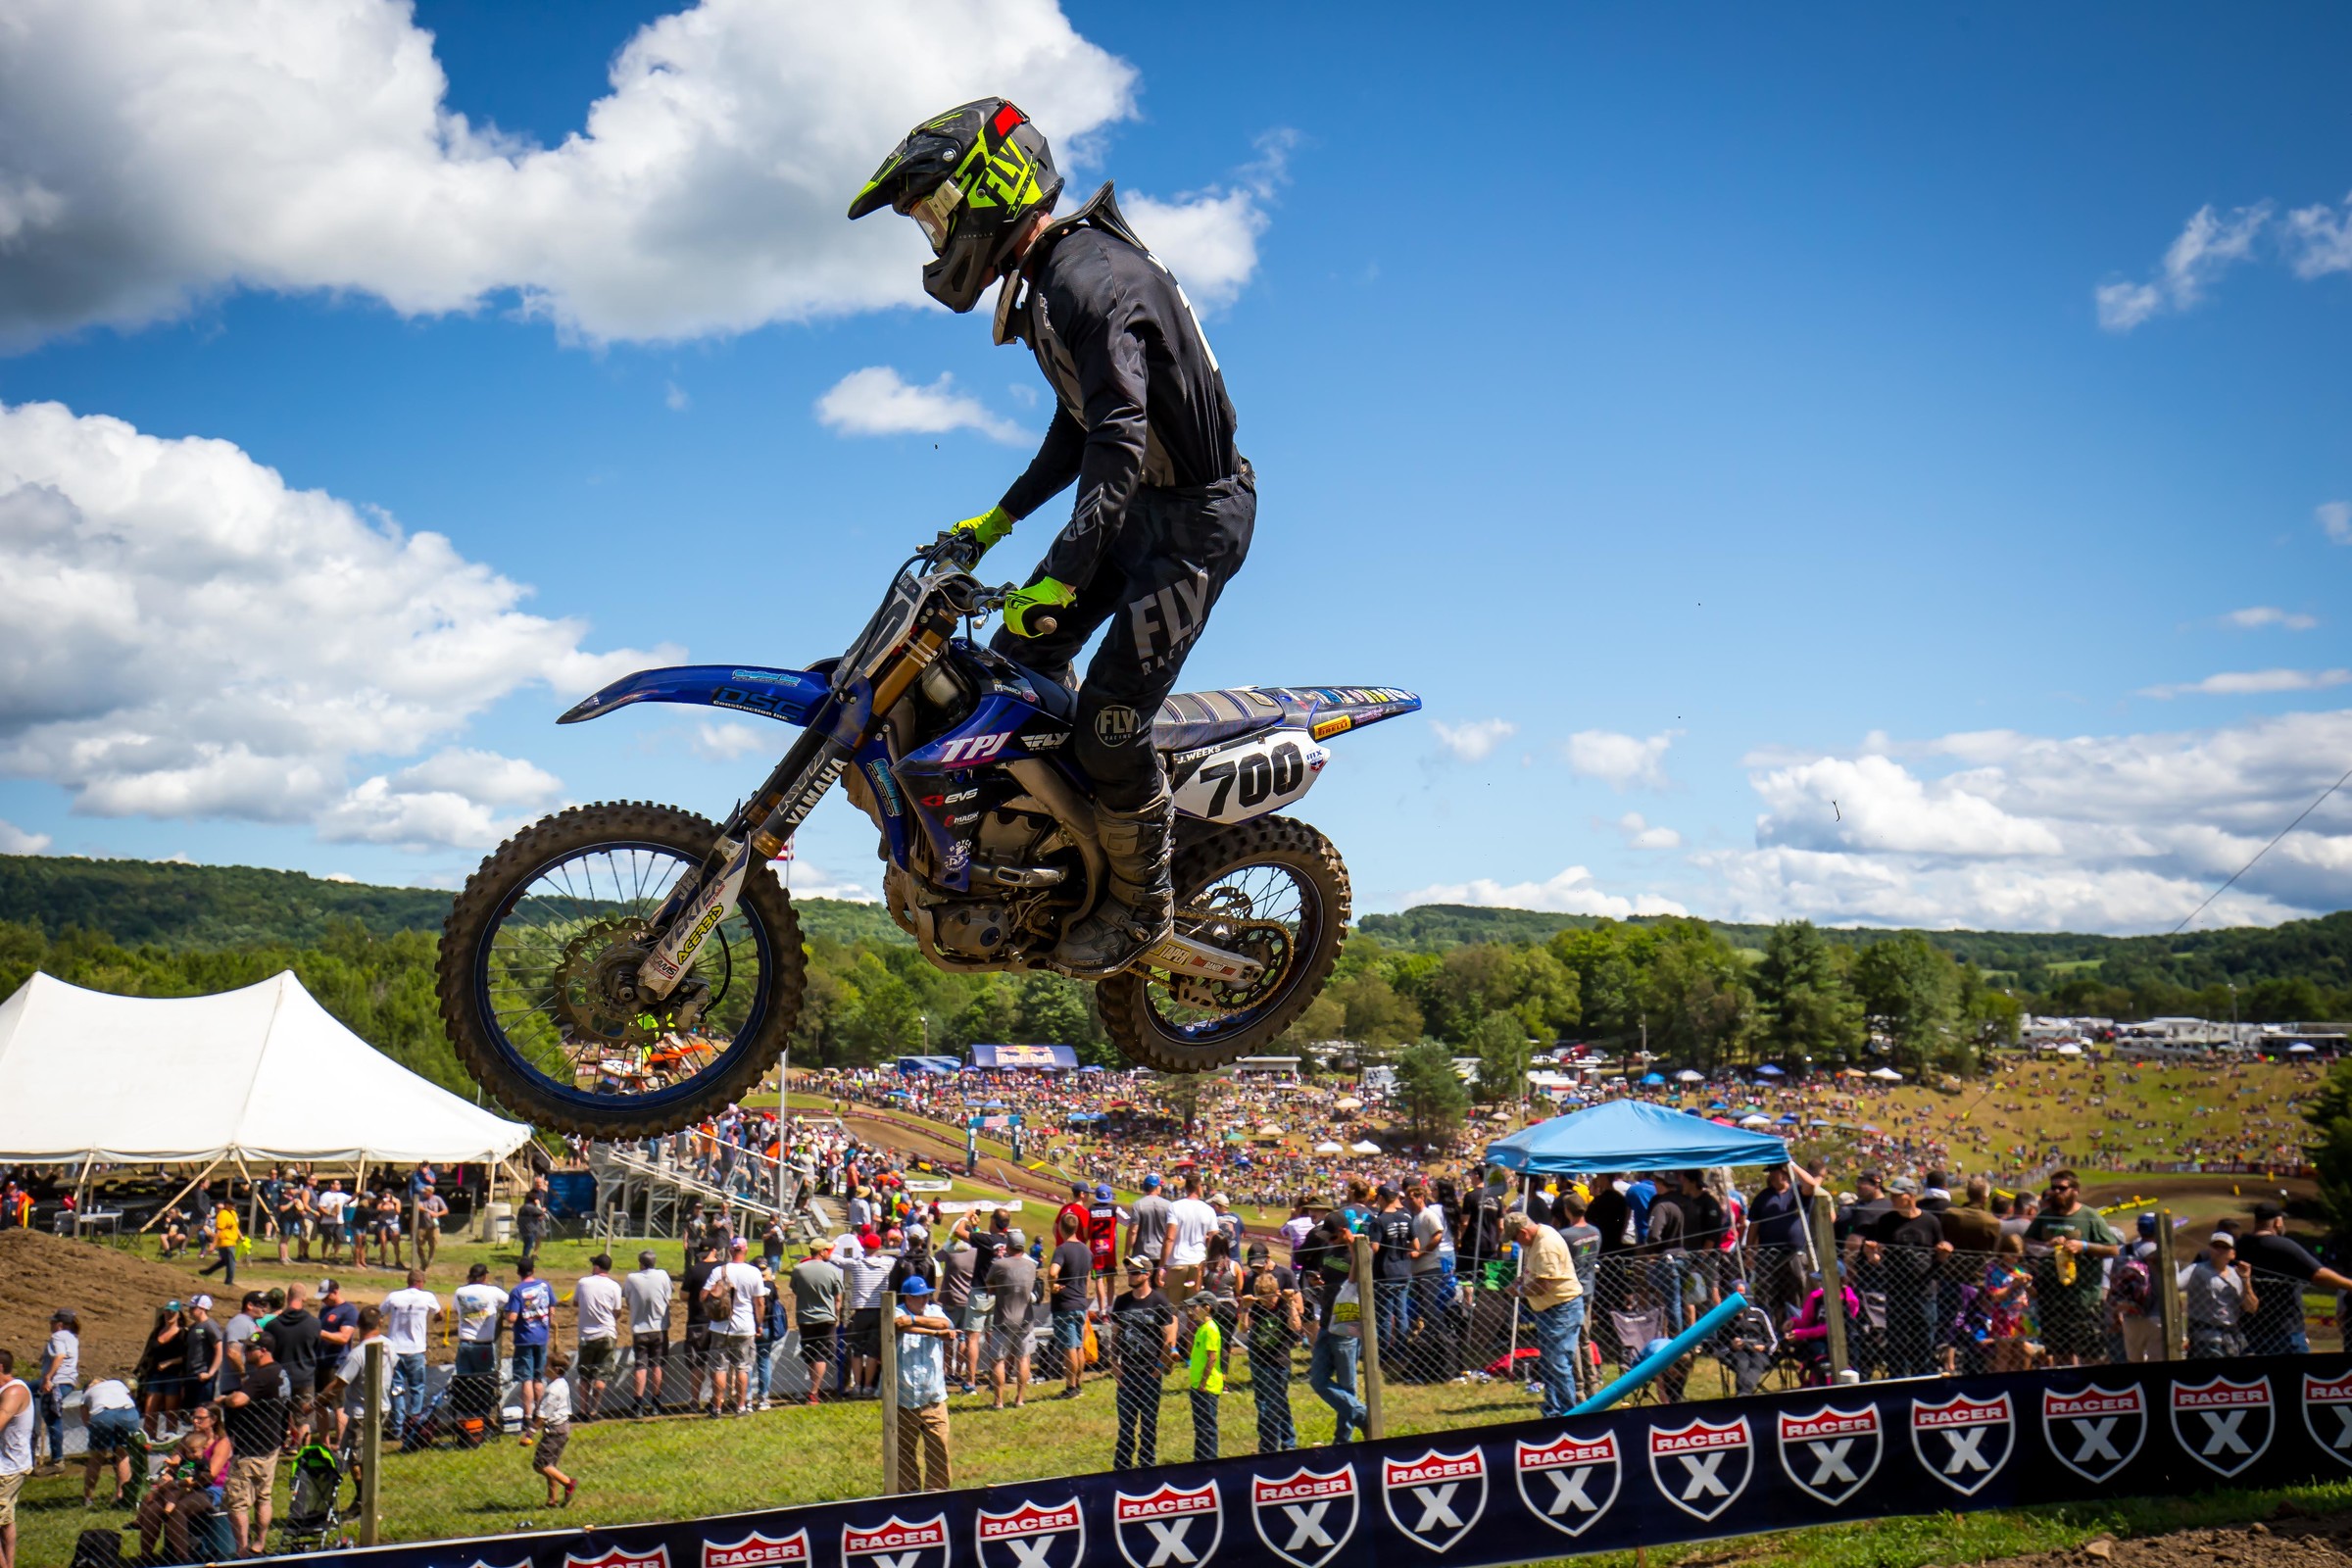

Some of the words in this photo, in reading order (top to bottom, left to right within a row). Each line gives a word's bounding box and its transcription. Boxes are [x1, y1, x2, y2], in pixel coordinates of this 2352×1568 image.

[976, 141, 1026, 208] FLY
[1011, 163, 1037, 212] RACING
[1128, 568, 1208, 660] FLY
[1141, 623, 1203, 676] RACING
[712, 700, 772, 716] Construction
[719, 687, 807, 719] DSC
[1100, 709, 1137, 734] FLY
[1317, 719, 1348, 736] PIRELLI
[941, 732, 1012, 762] TPJ
[1020, 732, 1070, 748] FLY
[1200, 741, 1304, 818] 700
[786, 758, 849, 826] YAMAHA
[949, 839, 972, 853] BOYCE
[677, 905, 724, 964] ACERBIS
[1159, 945, 1190, 965] TAPER
[1092, 1220, 1110, 1239] 2
[2180, 1391, 2264, 1404] RACER
[2311, 1386, 2352, 1397] RAC
[1919, 1407, 2002, 1424] RACER
[2050, 1397, 2133, 1413] RACER
[1787, 1419, 1870, 1436] RACER
[2073, 1417, 2122, 1461] X
[2200, 1411, 2252, 1454] X
[1656, 1432, 1740, 1449] RACER
[1941, 1428, 1990, 1473] X
[1524, 1446, 1608, 1465] RACER
[1808, 1440, 1858, 1485] X
[1392, 1462, 1476, 1482] RACER
[1679, 1452, 1730, 1499] X
[1260, 1480, 1347, 1499] RACER
[1546, 1467, 1597, 1515] X
[1124, 1496, 1210, 1516] RACER
[1412, 1484, 1464, 1532] X
[985, 1514, 1072, 1535] RACER
[1283, 1501, 1335, 1550] X
[850, 1531, 937, 1549] RACER
[1145, 1518, 1198, 1567] X
[711, 1545, 799, 1565] RACER
